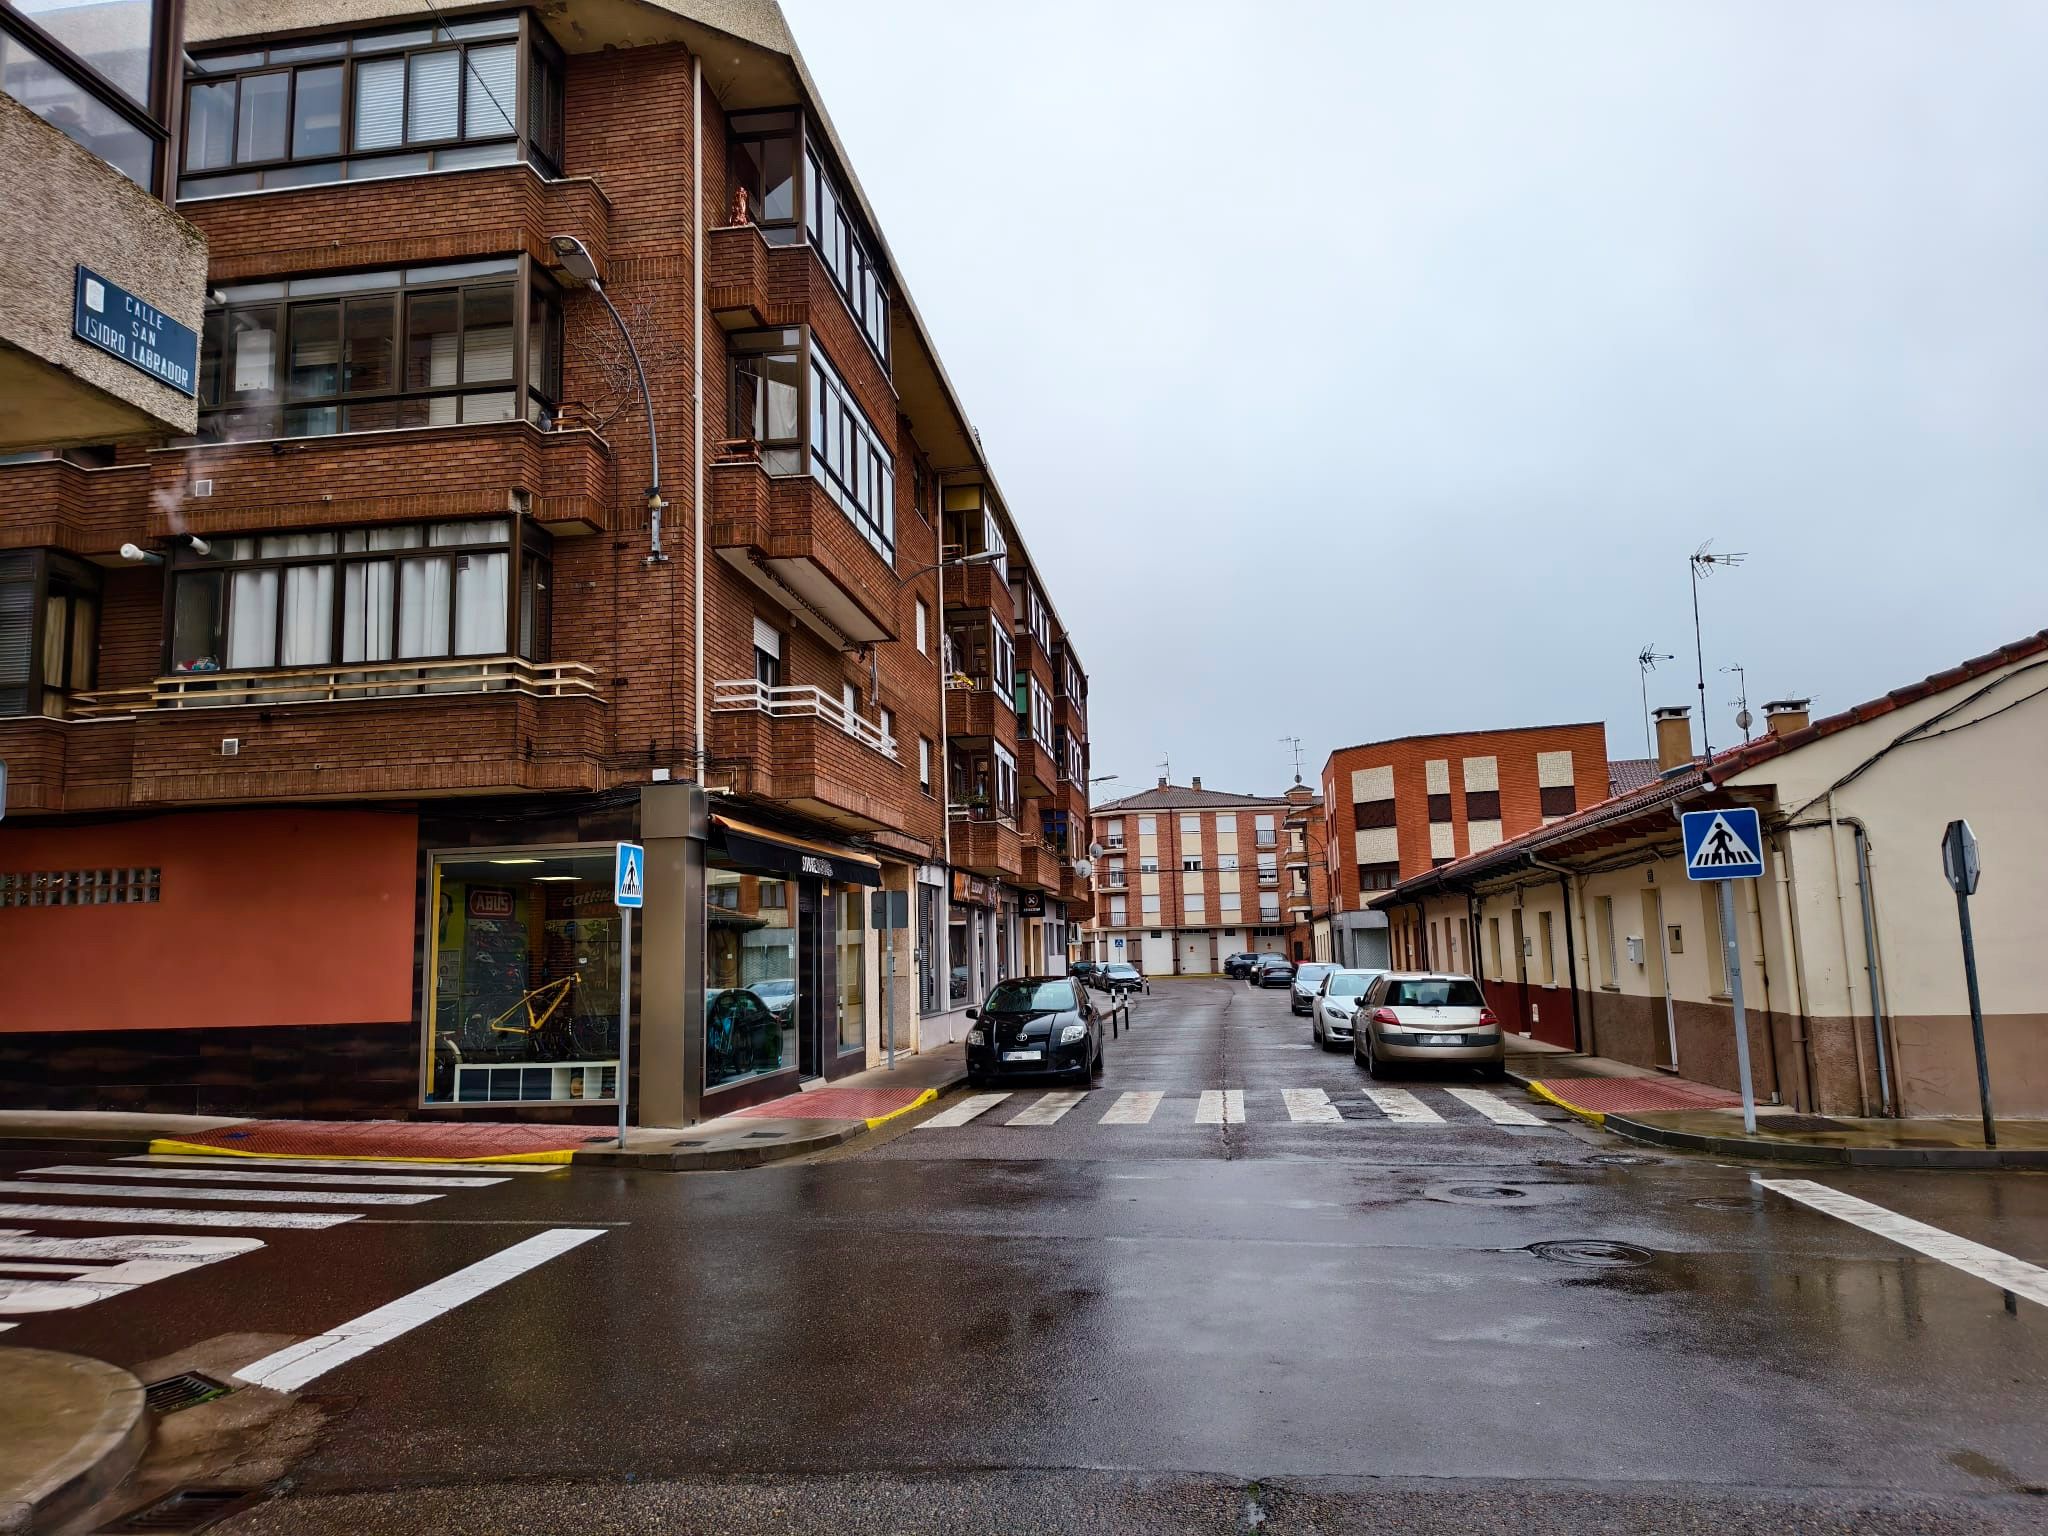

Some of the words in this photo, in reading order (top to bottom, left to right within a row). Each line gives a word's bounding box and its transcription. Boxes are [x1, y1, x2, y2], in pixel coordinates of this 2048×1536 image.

[125, 296, 164, 331] CALLE
[131, 321, 156, 347] SAN
[85, 316, 126, 354] ISIDRO
[132, 341, 189, 388] LABRADOR
[476, 894, 509, 912] ABUS
